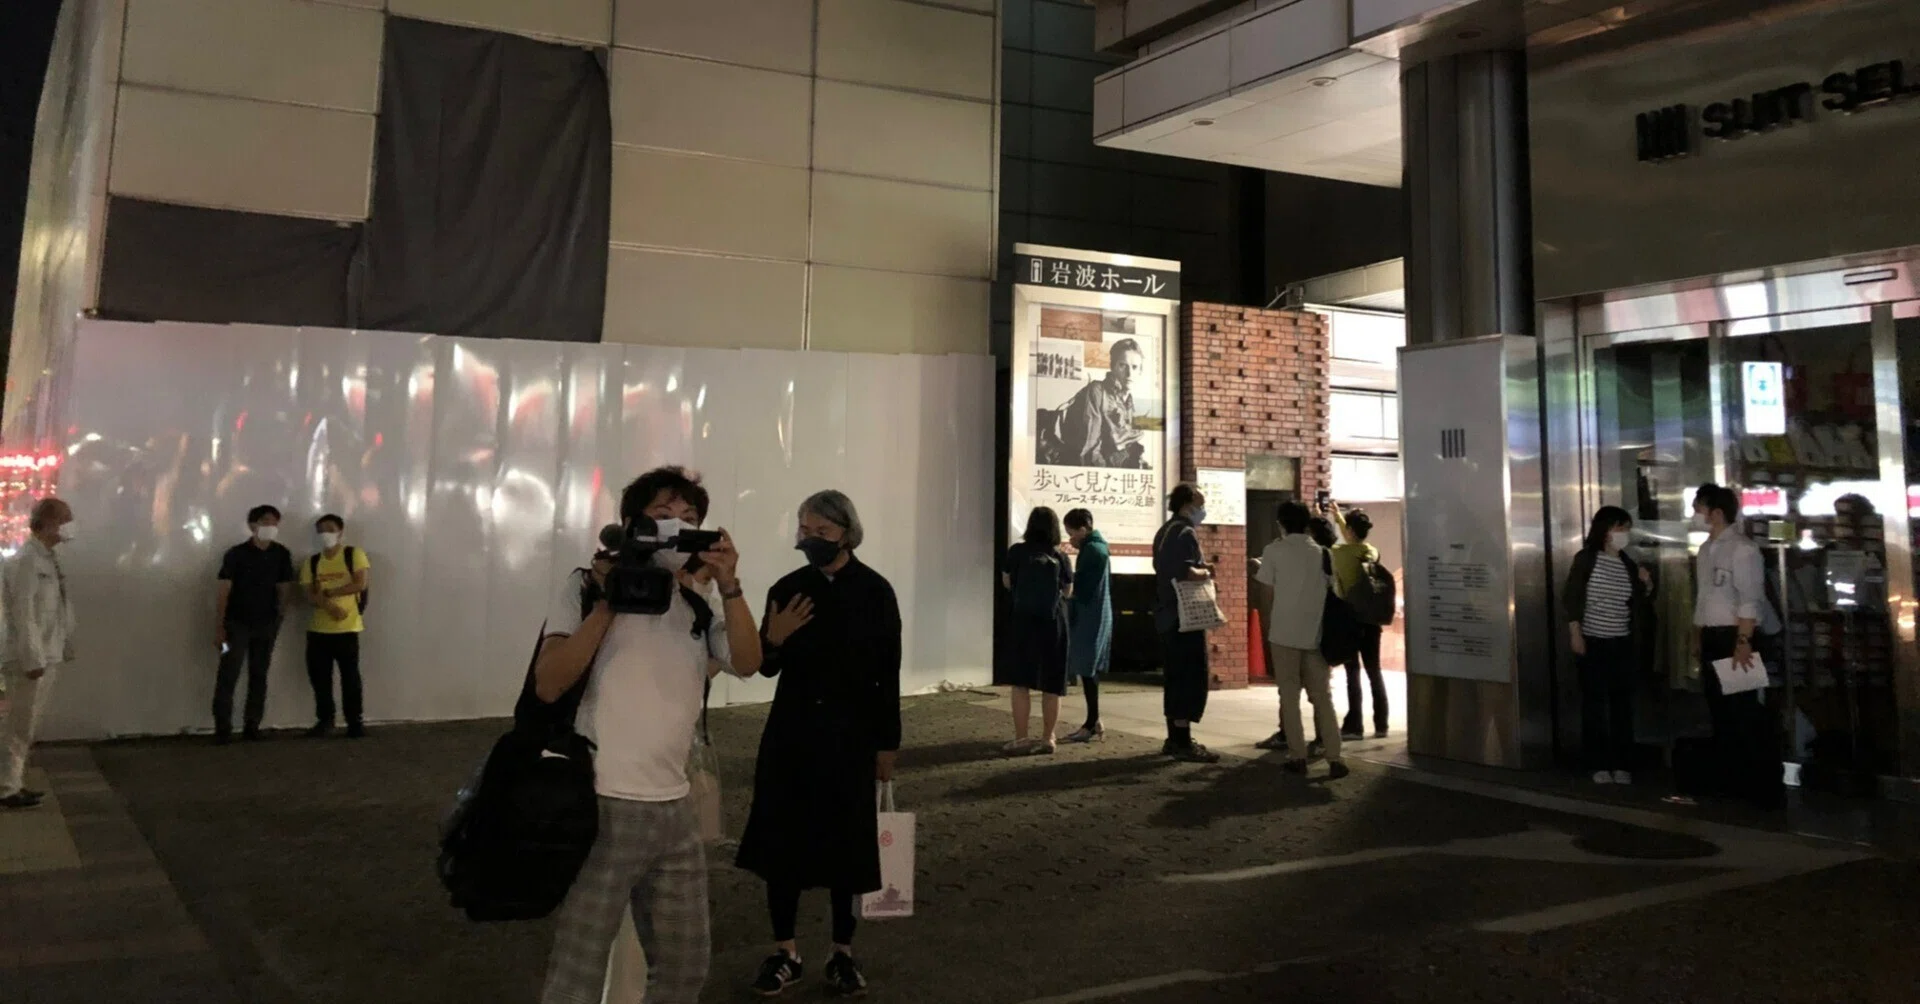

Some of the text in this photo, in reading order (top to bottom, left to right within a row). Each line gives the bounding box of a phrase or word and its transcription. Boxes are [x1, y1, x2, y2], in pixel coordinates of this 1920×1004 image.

[1050, 261, 1166, 295] 岩波ホール
[1033, 469, 1156, 494] 歩いて見た世界
